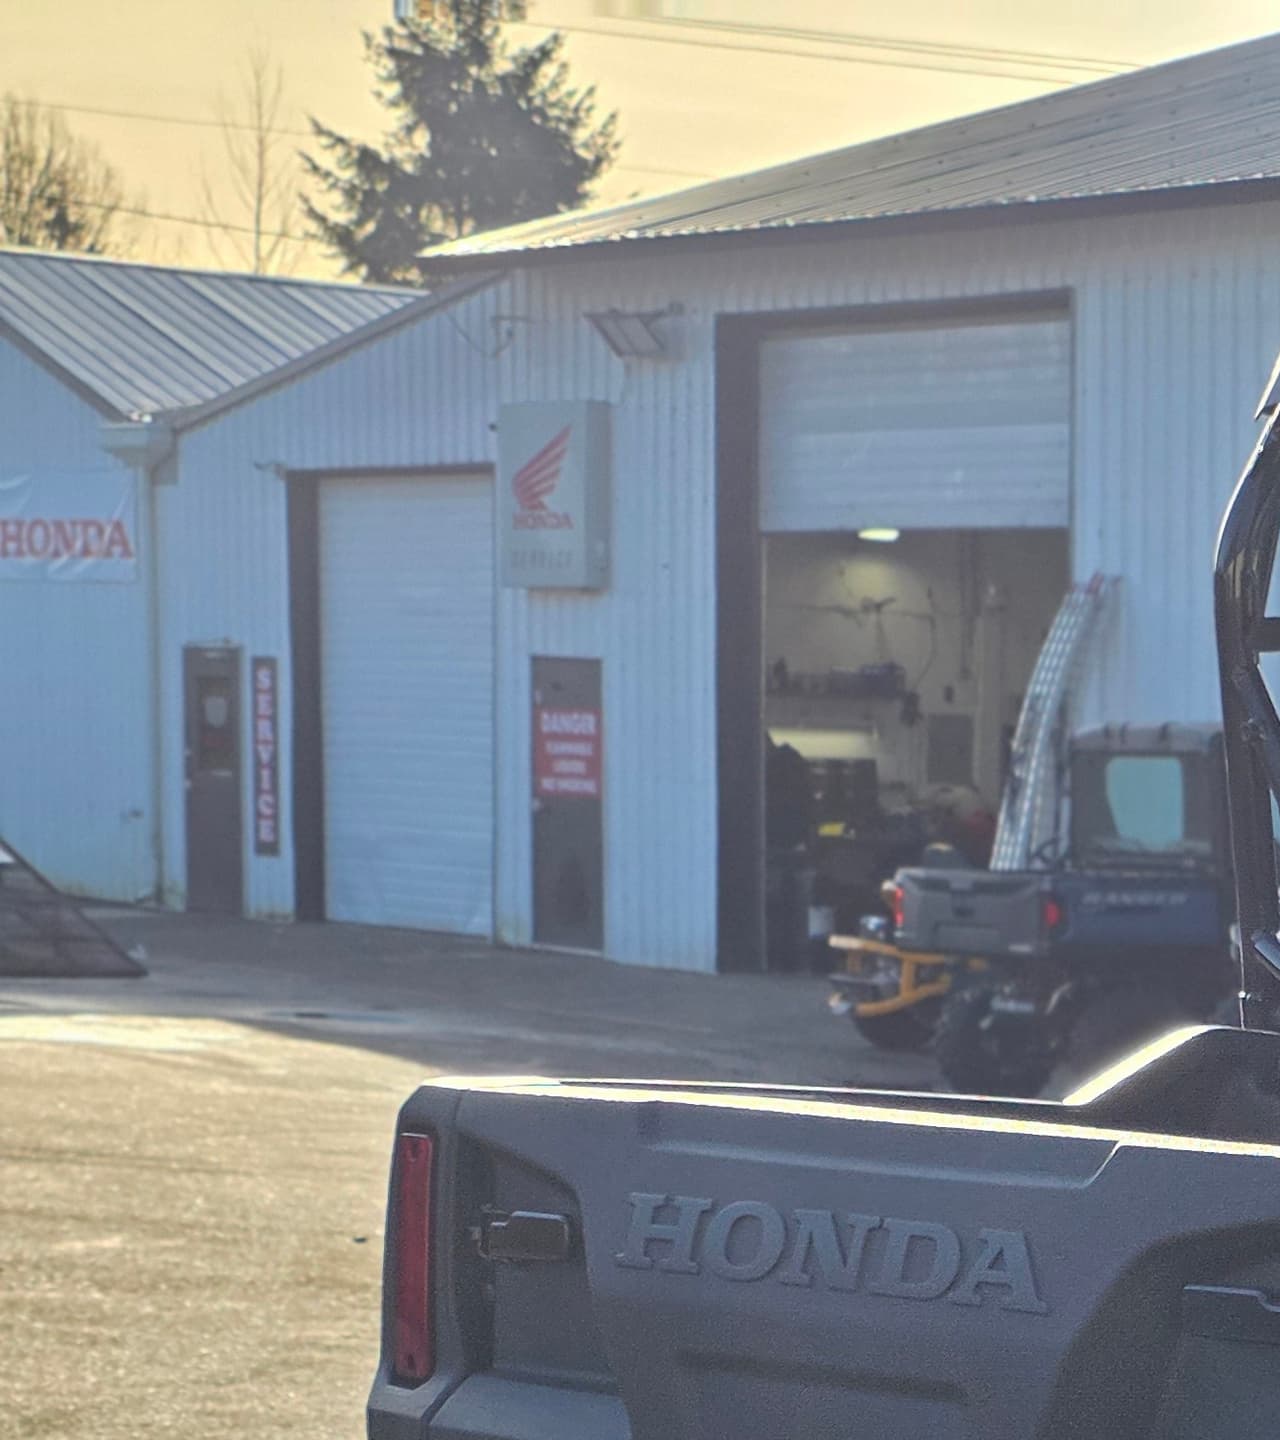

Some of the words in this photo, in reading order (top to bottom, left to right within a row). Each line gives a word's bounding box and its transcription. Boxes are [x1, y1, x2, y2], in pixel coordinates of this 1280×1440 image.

[0, 518, 134, 560] HONDA
[256, 665, 275, 843] SERVICE
[613, 1191, 1052, 1316] HONDA
